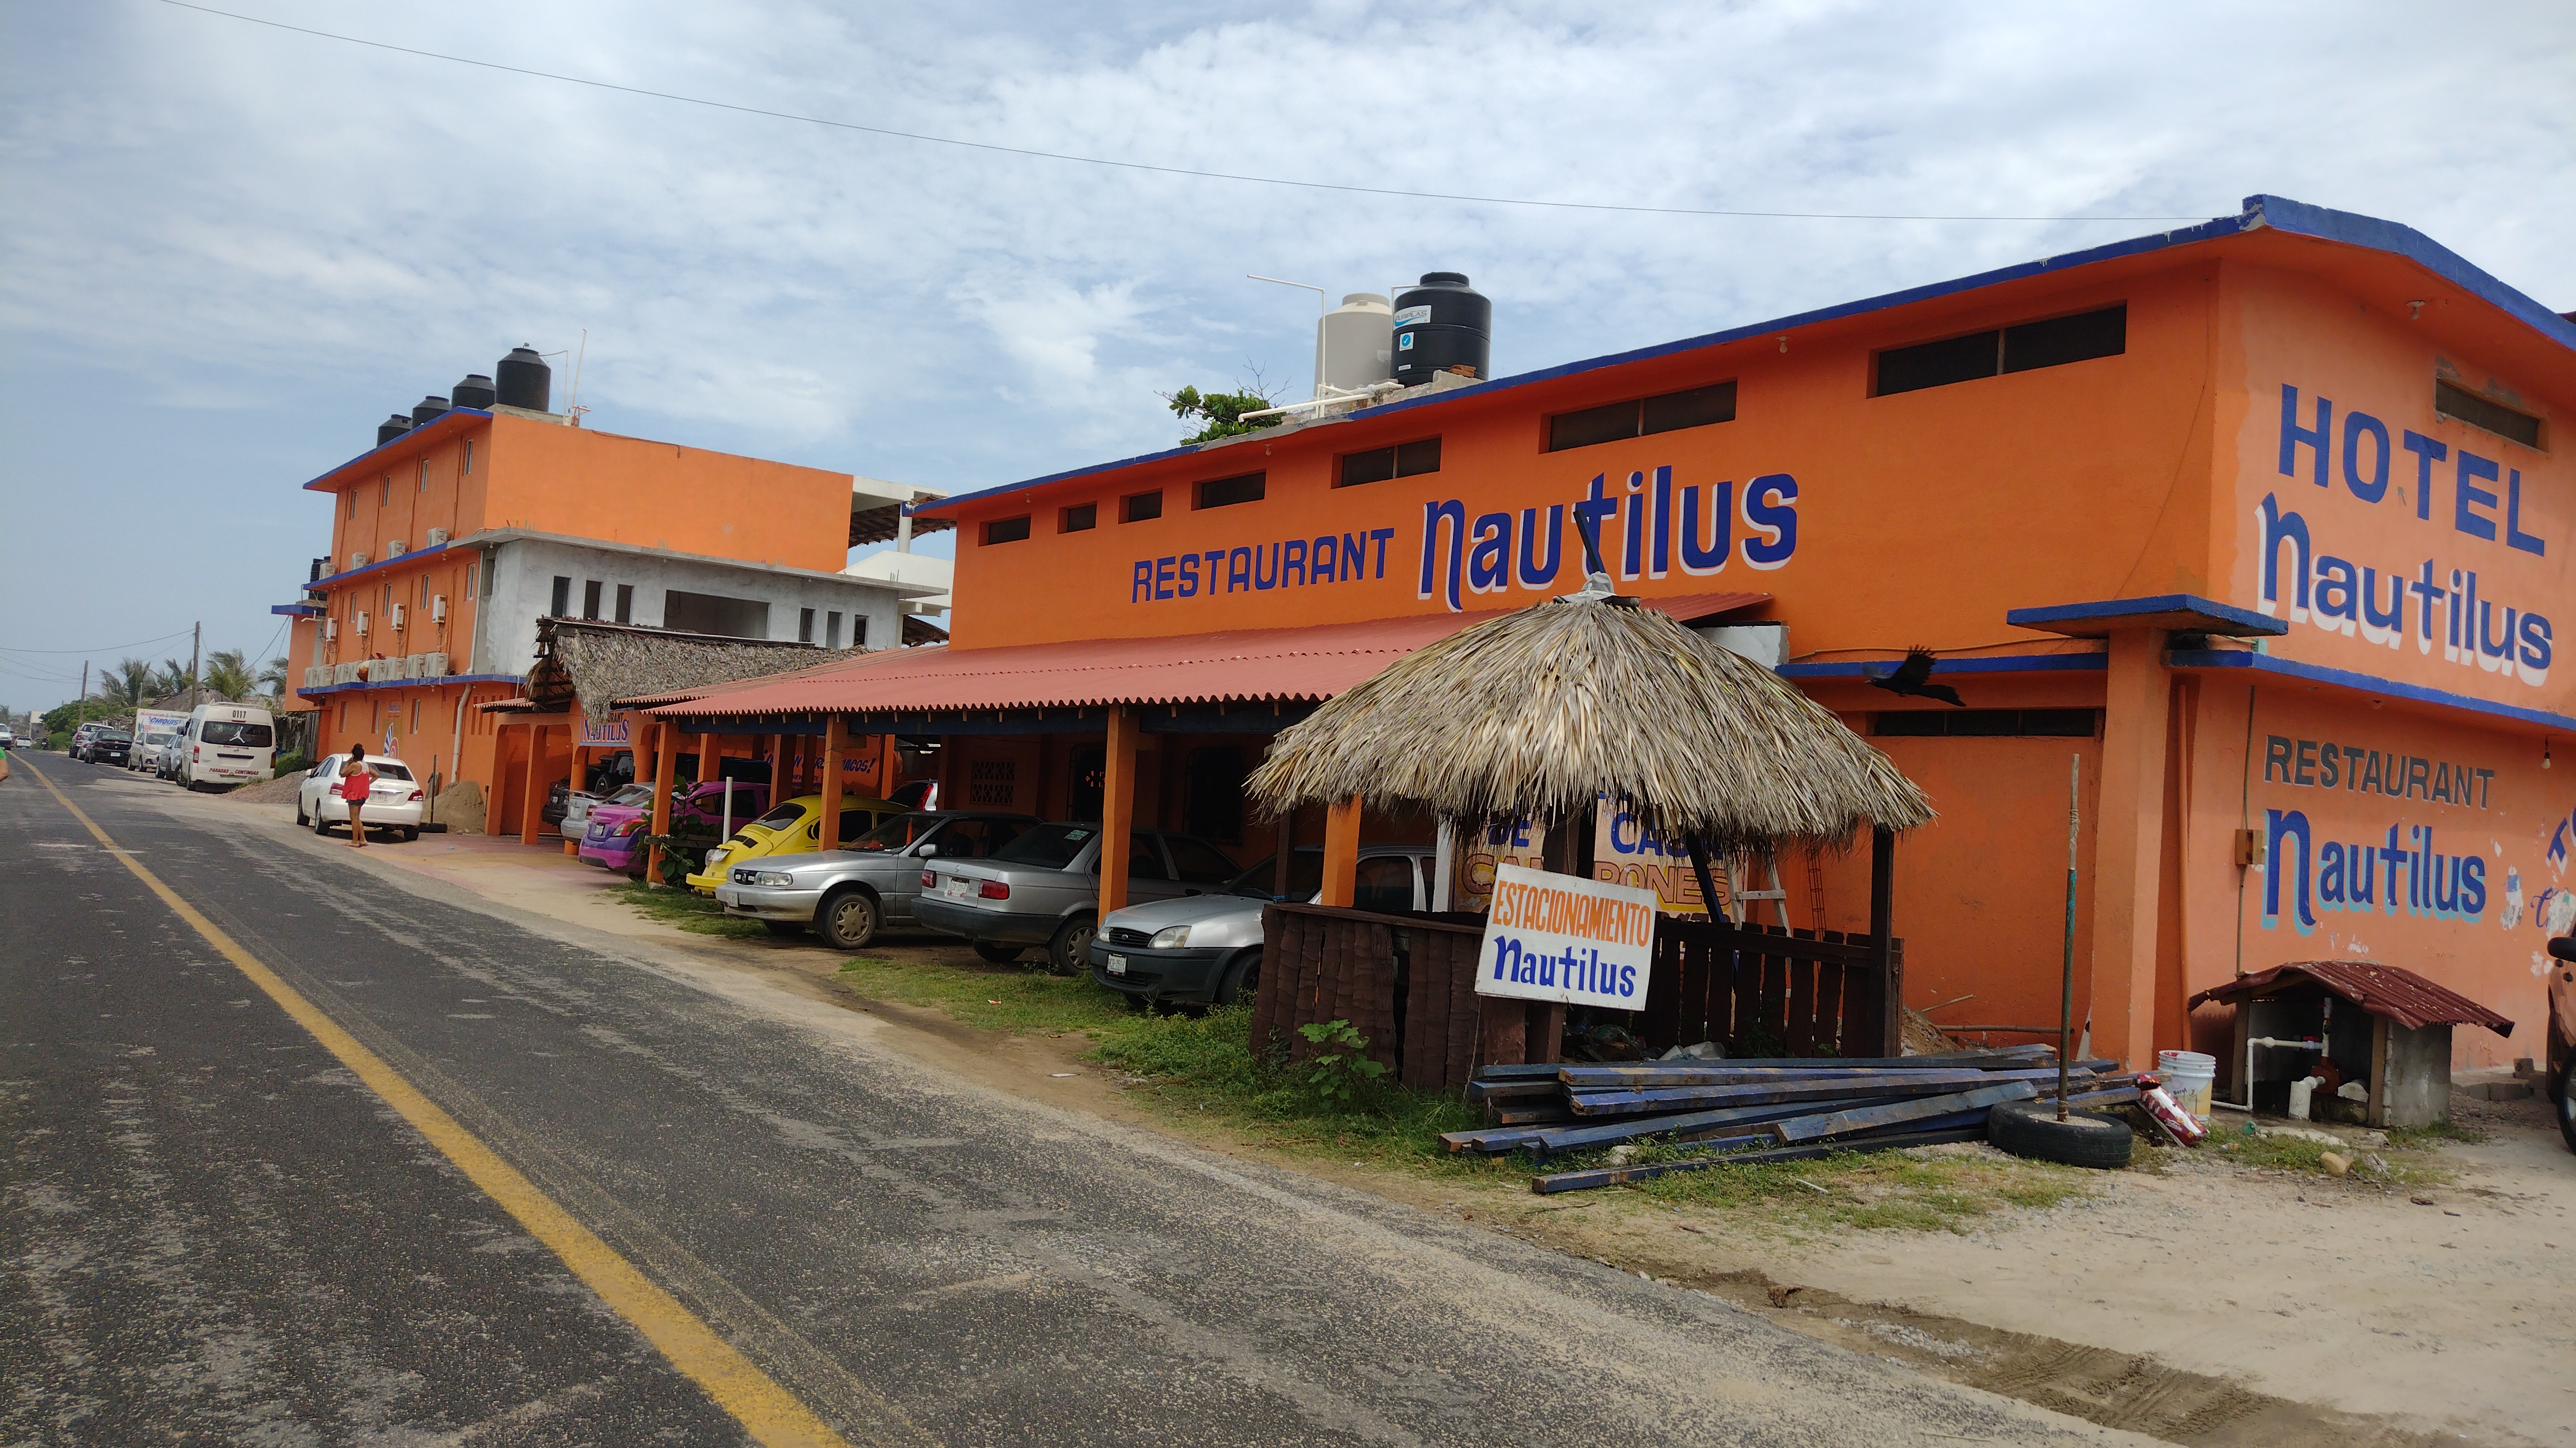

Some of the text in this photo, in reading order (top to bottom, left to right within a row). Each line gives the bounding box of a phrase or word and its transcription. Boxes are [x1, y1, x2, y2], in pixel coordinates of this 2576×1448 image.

[2278, 383, 2545, 557] HOTEL
[1132, 528, 1396, 604] RESTAURANT
[232, 710, 247, 719] 0117
[2263, 734, 2495, 810] RESTAURANT
[1492, 879, 1651, 947] ESTACIONAMIENTO
